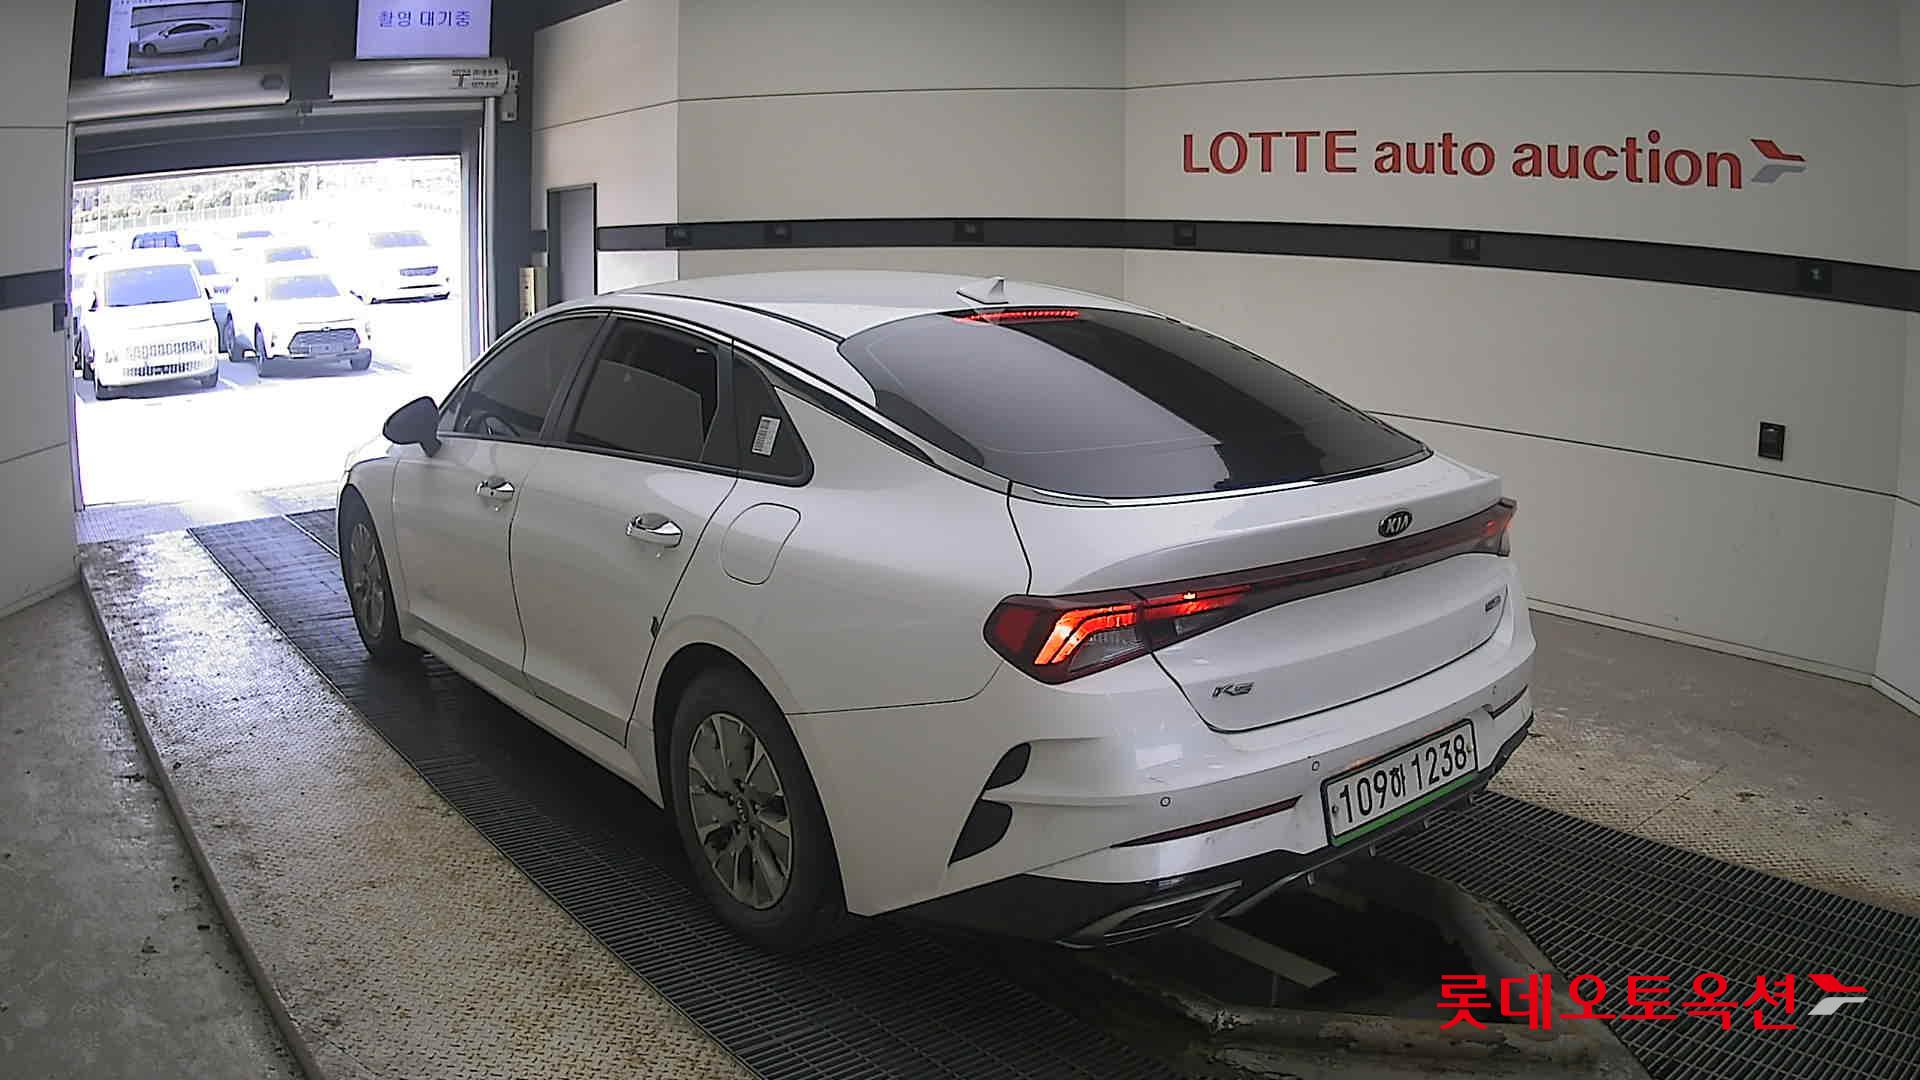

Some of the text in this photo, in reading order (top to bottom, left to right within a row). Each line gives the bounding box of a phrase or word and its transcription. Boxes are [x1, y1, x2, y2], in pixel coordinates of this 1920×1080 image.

[420, 10, 471, 28] 대기중
[1184, 130, 1742, 189] LOTTE auto auction
[1383, 513, 1410, 535] KIA
[1211, 681, 1254, 697] K5
[1339, 734, 1467, 823] 109하 1238
